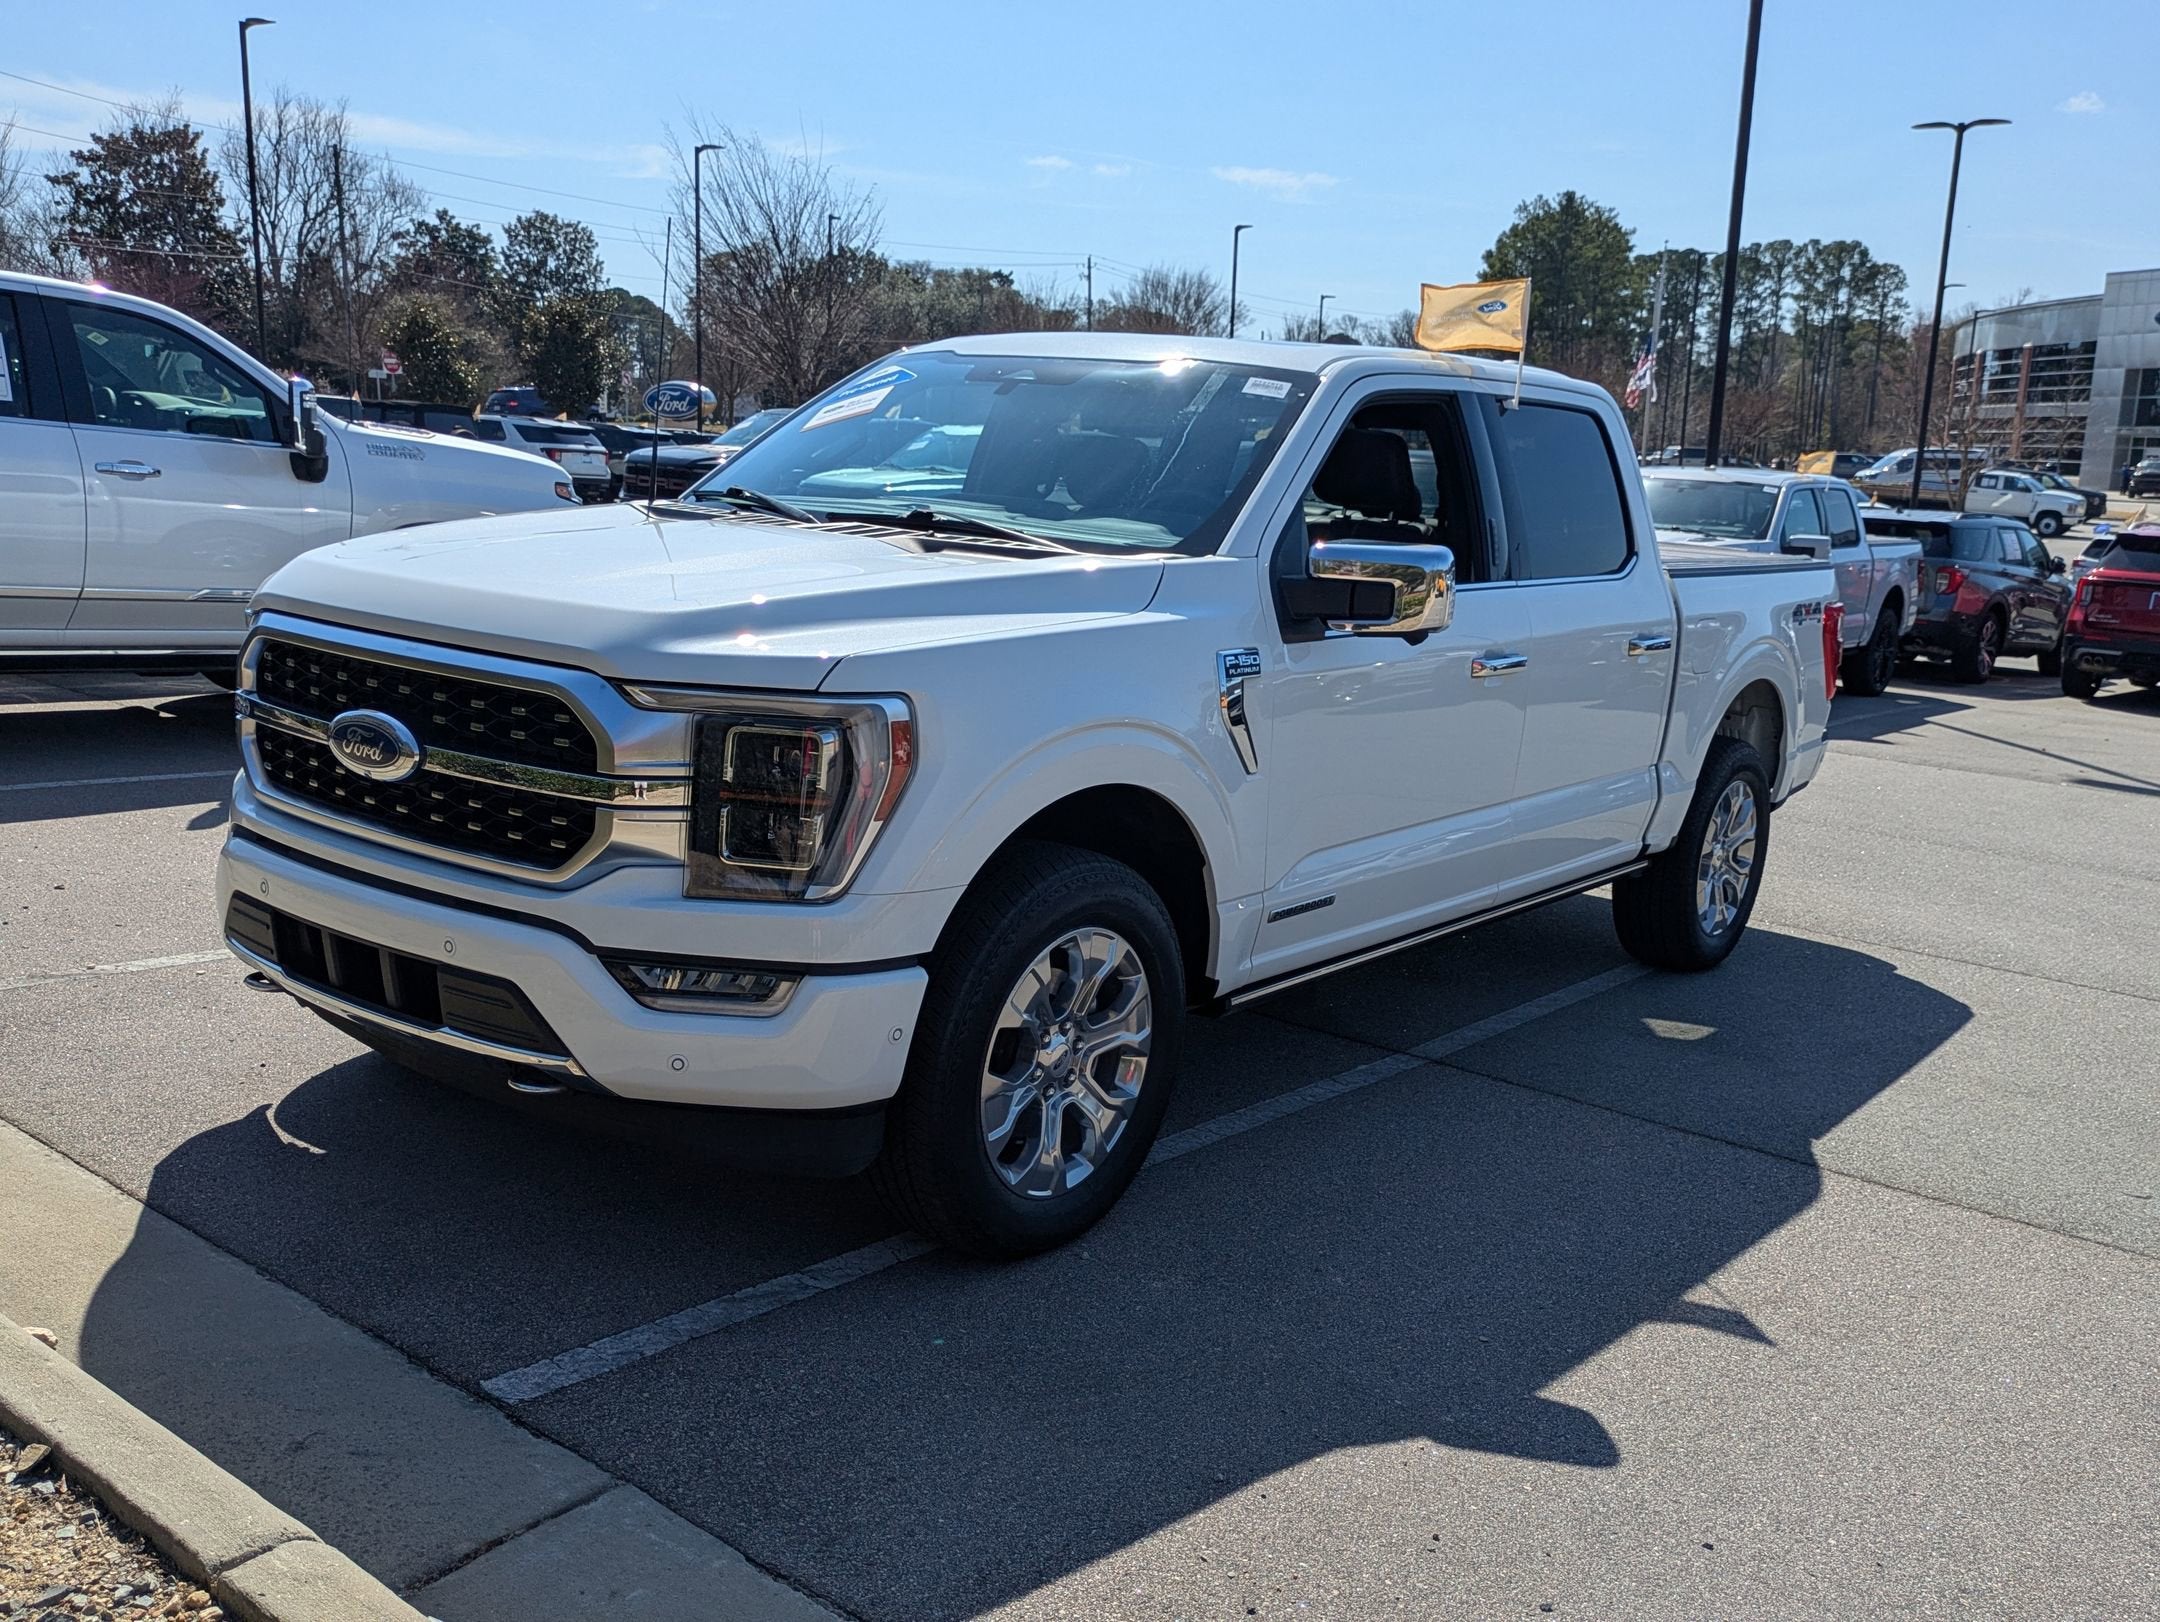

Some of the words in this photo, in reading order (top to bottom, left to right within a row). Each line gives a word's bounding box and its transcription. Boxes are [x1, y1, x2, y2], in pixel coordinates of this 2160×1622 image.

[654, 390, 691, 412] Ford
[1225, 654, 1260, 668] F-150
[1229, 666, 1260, 675] PLATINUM
[342, 727, 385, 761] Ford
